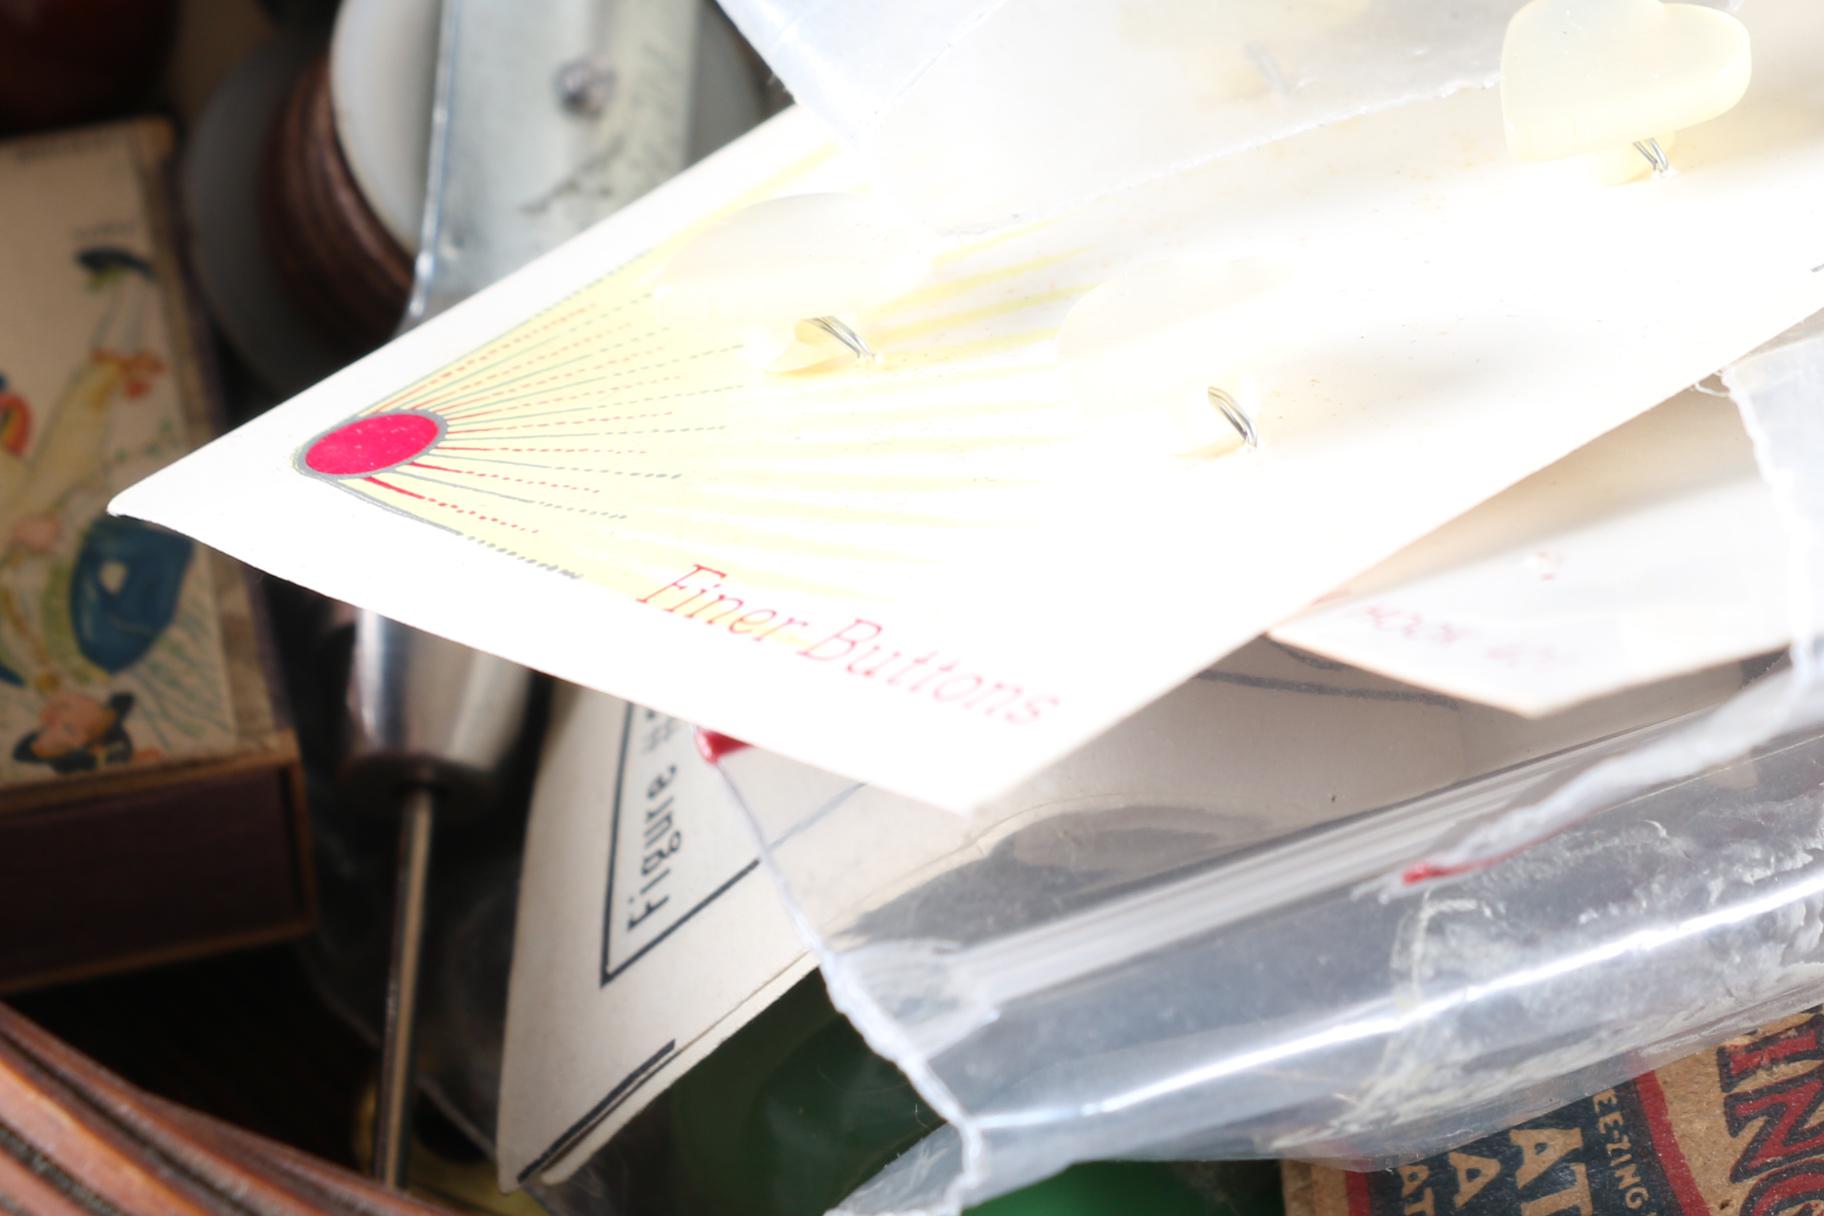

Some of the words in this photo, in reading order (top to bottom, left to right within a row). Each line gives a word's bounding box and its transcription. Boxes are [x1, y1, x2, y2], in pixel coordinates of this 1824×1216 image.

[636, 563, 809, 643] Finer
[796, 617, 1061, 726] Buttons
[626, 764, 682, 931] Figure
